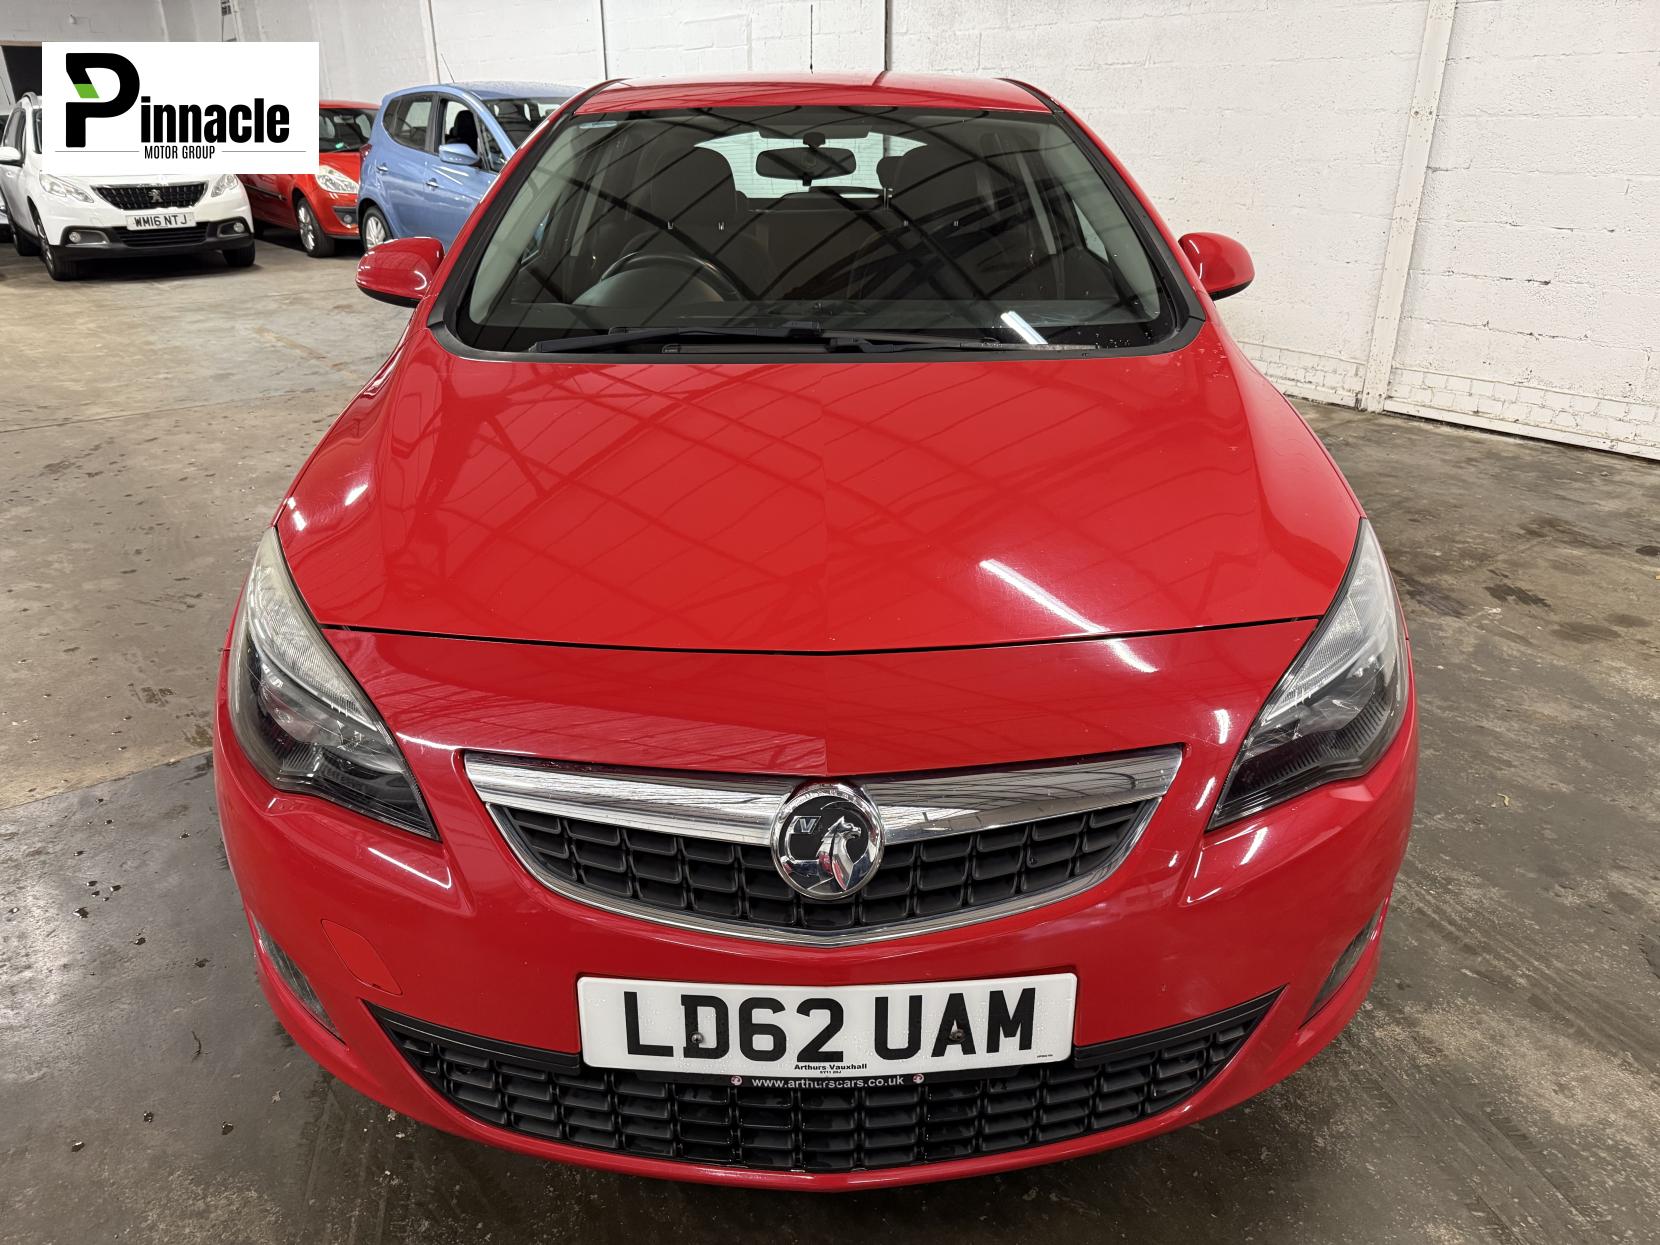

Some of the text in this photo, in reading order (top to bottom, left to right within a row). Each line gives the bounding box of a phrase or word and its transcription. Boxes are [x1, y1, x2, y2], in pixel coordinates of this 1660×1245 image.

[134, 214, 187, 227] WM16 NTJ
[623, 987, 1036, 1062] LD62 UAM
[751, 1076, 904, 1089] www.arthurscars.co.uk
